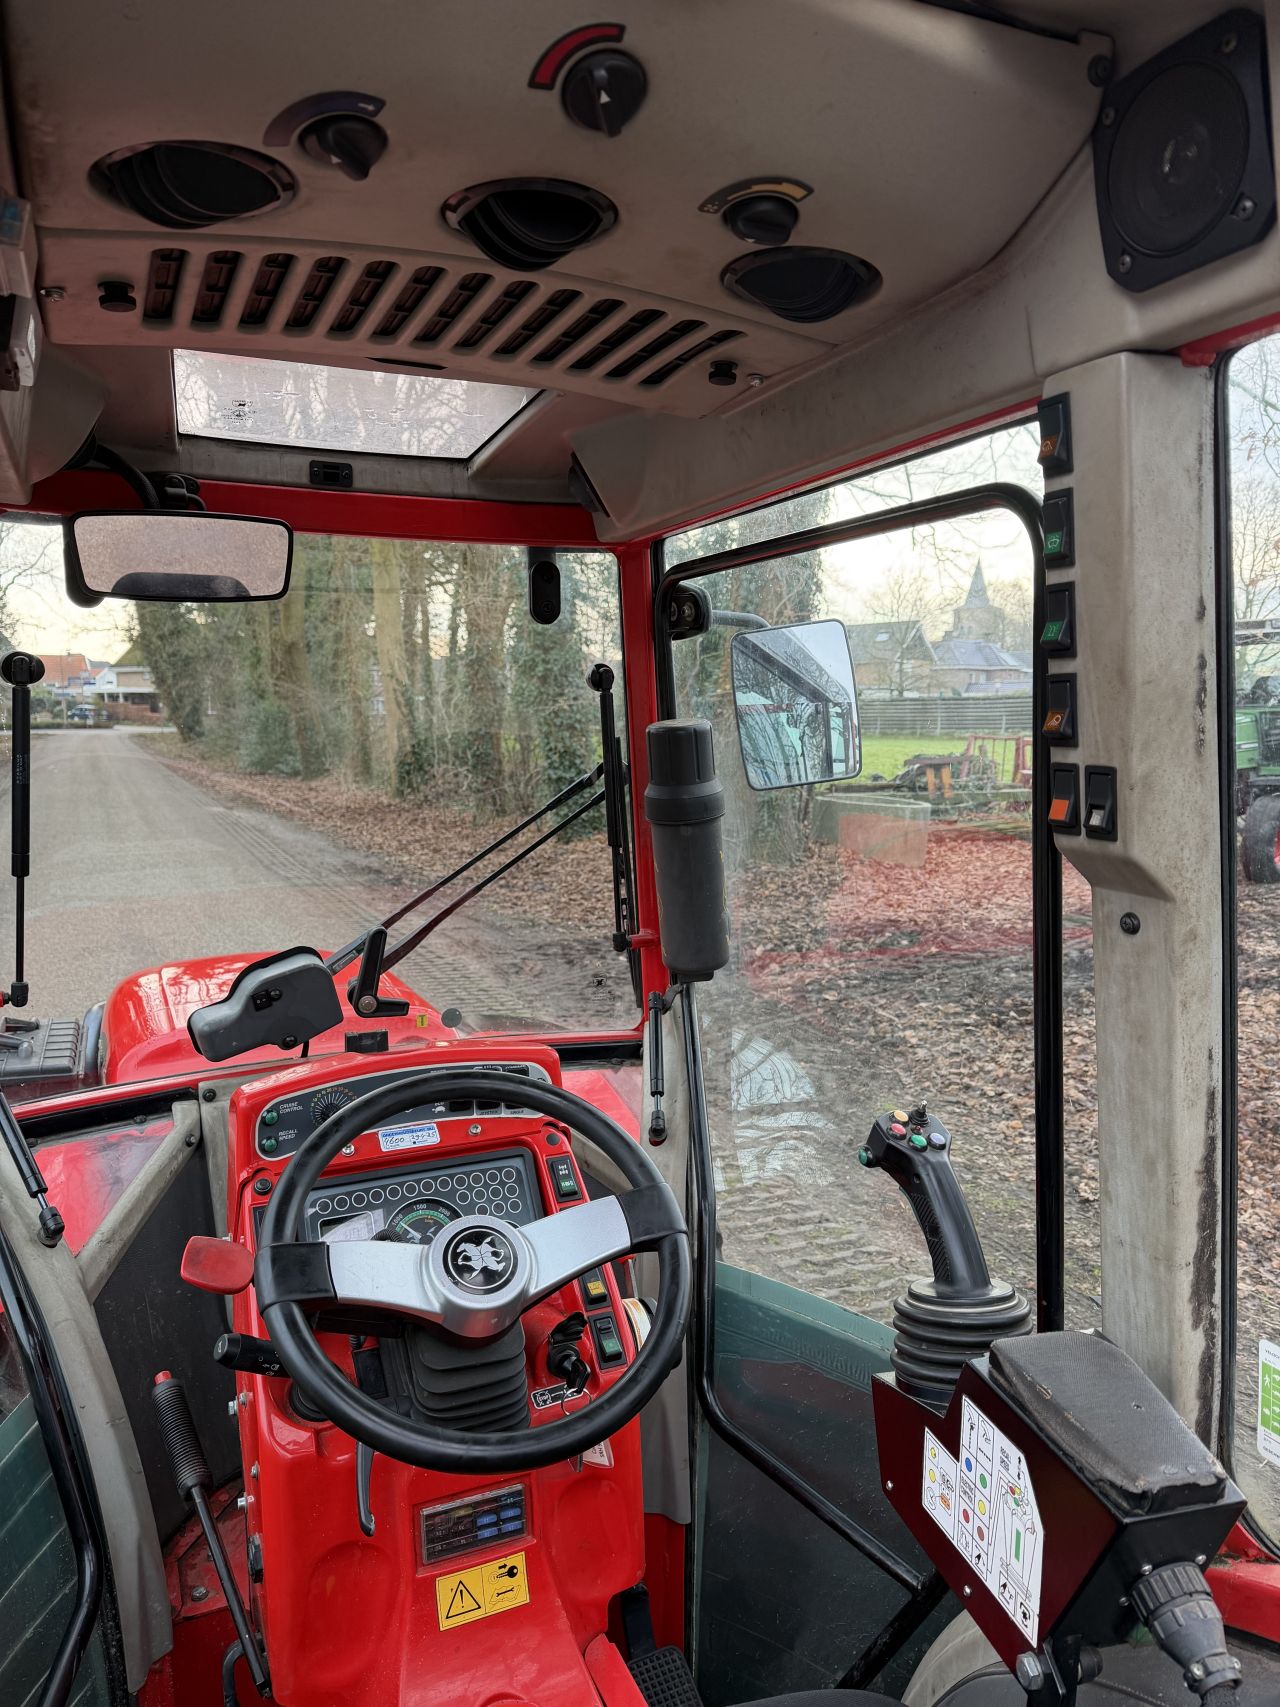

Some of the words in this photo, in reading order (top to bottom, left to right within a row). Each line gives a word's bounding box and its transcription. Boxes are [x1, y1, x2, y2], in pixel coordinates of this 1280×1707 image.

[279, 1101, 299, 1110] CRUISE
[279, 1105, 304, 1114] CONTROL
[413, 1203, 427, 1211] 1500
[438, 1206, 451, 1217] 2000
[391, 1213, 404, 1226] 1000
